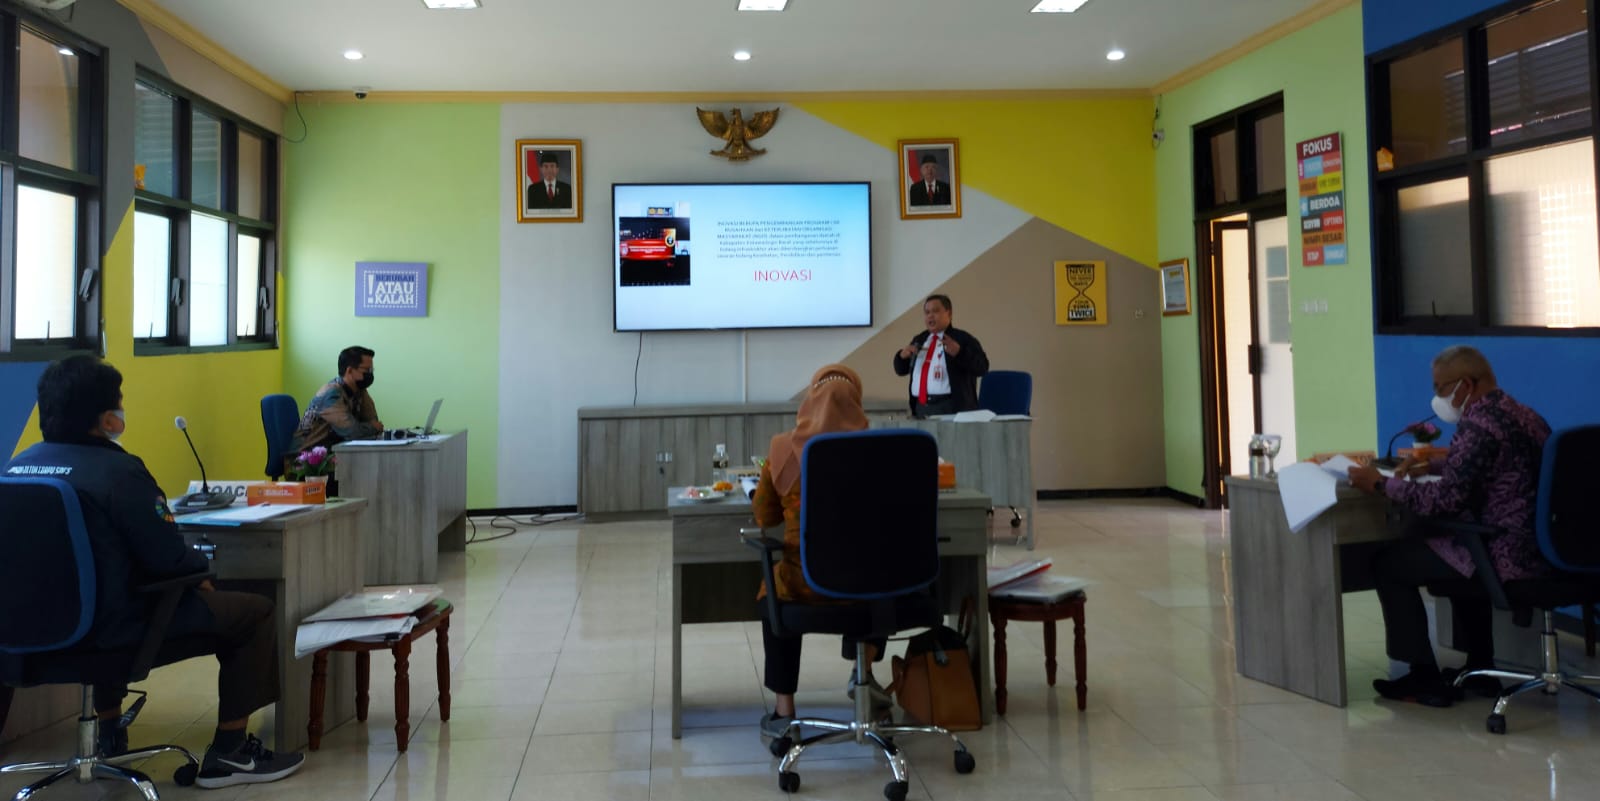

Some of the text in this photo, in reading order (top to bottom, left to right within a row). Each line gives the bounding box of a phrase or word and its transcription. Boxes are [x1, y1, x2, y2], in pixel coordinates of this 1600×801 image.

[1303, 137, 1332, 156] FOKUS
[1309, 195, 1340, 211] BERDOA
[753, 269, 812, 282] INOVASI
[375, 281, 414, 294] ATAU
[375, 294, 414, 305] KALAH
[200, 485, 248, 497] OAC
